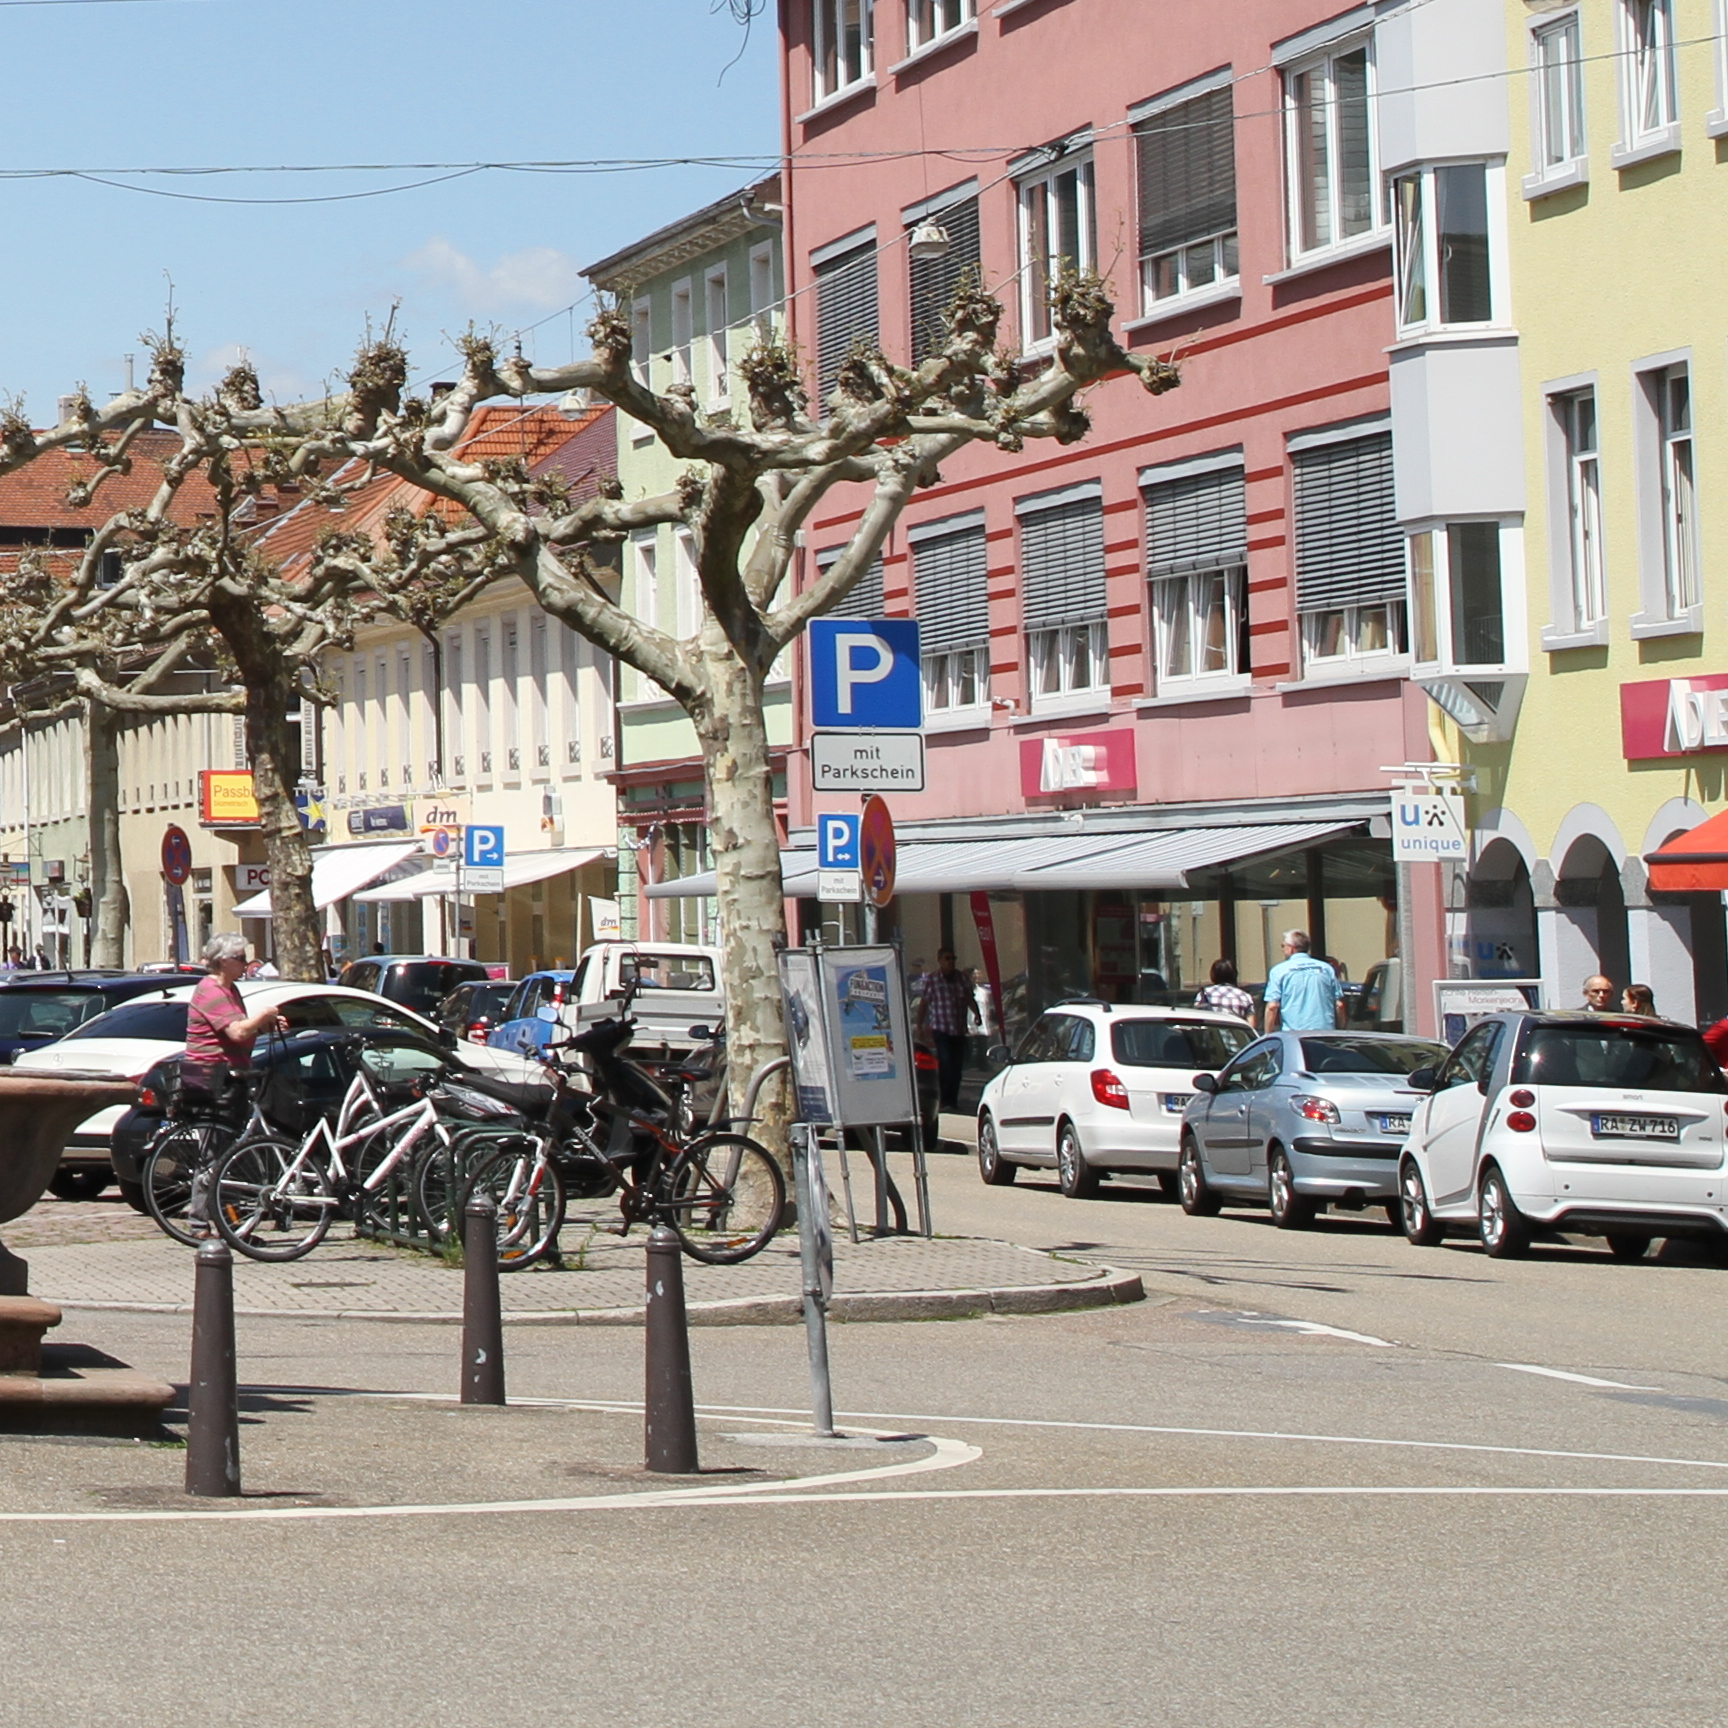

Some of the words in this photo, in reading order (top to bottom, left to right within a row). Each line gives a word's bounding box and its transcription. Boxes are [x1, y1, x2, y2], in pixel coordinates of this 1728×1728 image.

[835, 633, 894, 714] P
[854, 746, 881, 760] mit
[821, 764, 915, 780] Parkschein
[426, 806, 458, 824] dm
[473, 829, 495, 862] P
[827, 820, 850, 862] P
[1401, 836, 1462, 853] unique
[821, 885, 857, 894] Parkschein
[1388, 1116, 1406, 1128] RA
[1600, 1117, 1619, 1131] RA
[1628, 1118, 1647, 1132] ZW
[1649, 1119, 1676, 1134] 716
